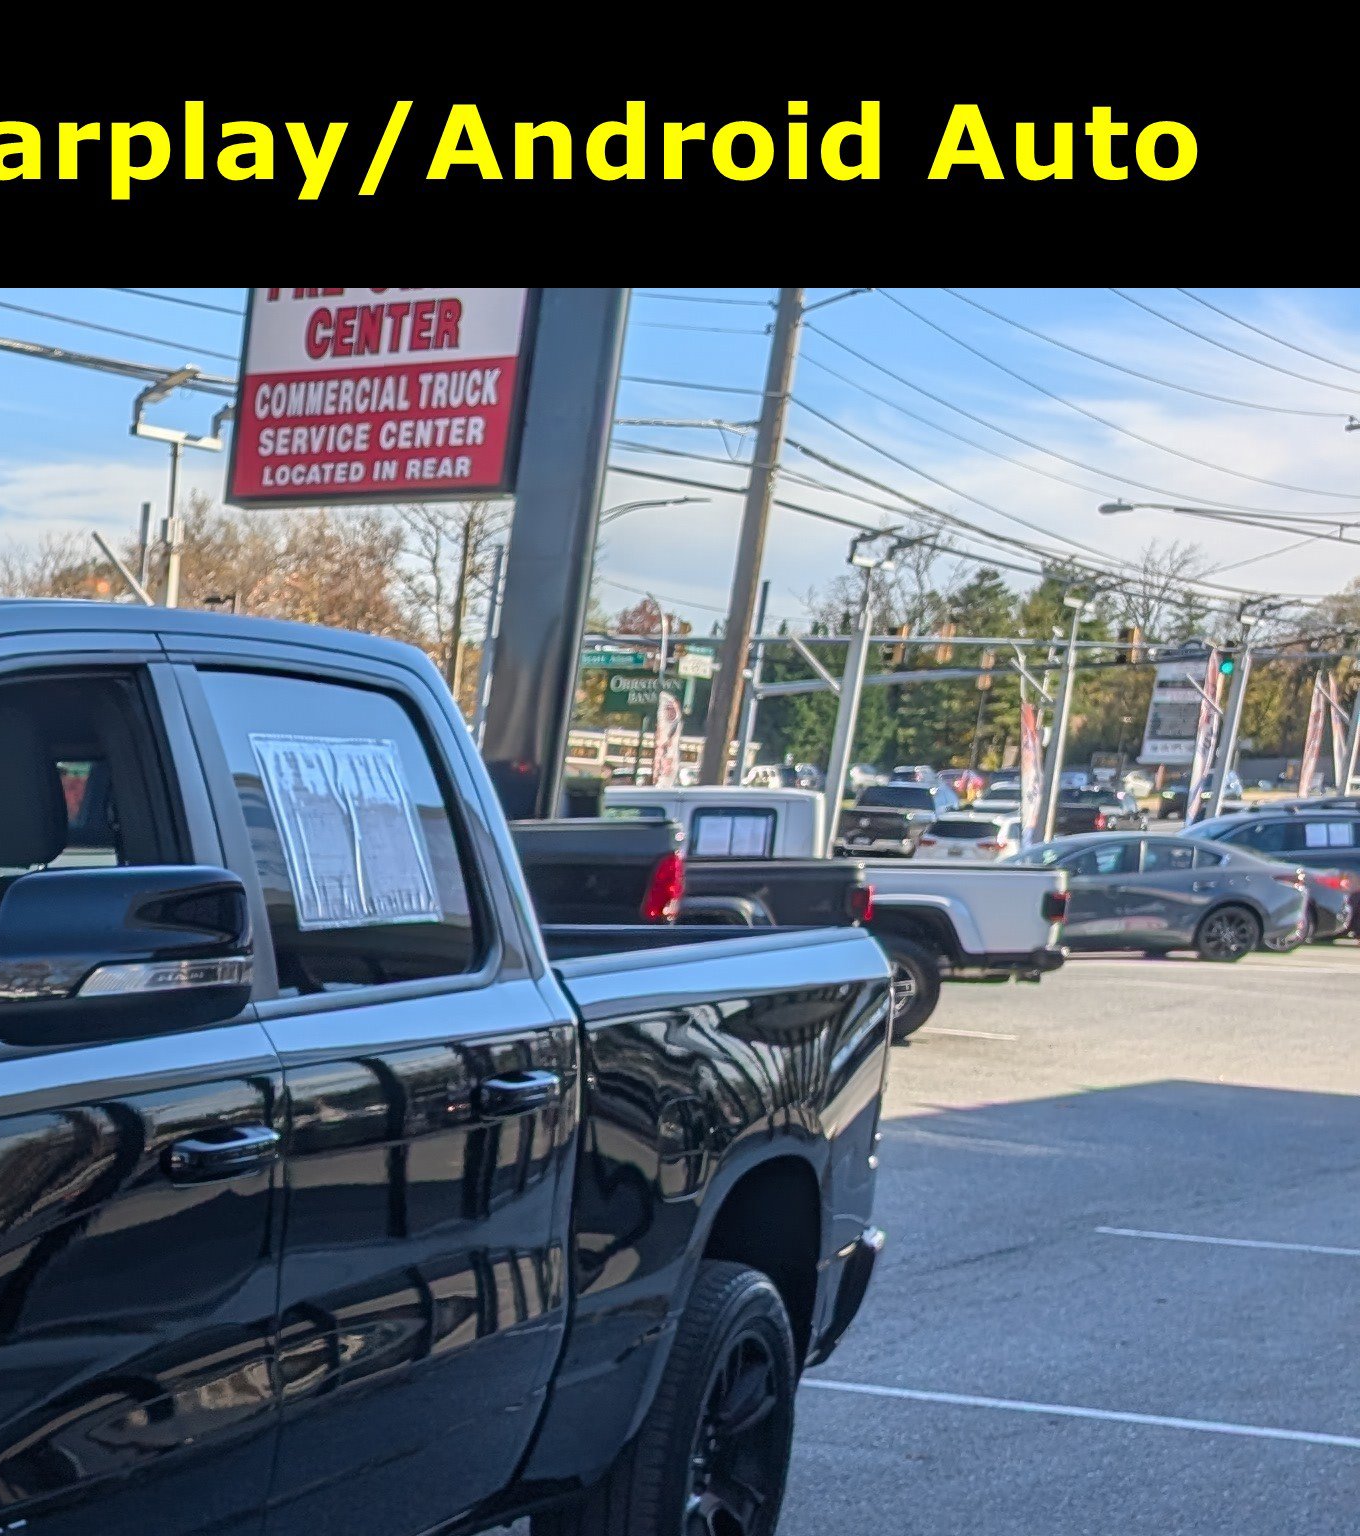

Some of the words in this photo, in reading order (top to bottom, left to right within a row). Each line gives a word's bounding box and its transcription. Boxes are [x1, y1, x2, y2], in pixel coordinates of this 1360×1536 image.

[305, 298, 462, 359] CENTER
[254, 375, 411, 419] COMMERCIAL
[418, 367, 501, 409] TRUCK
[258, 422, 372, 457] SERVICE
[379, 415, 486, 450] CENTER
[262, 462, 366, 486] LOCATED
[372, 459, 398, 481] IN
[405, 455, 472, 479] REAR
